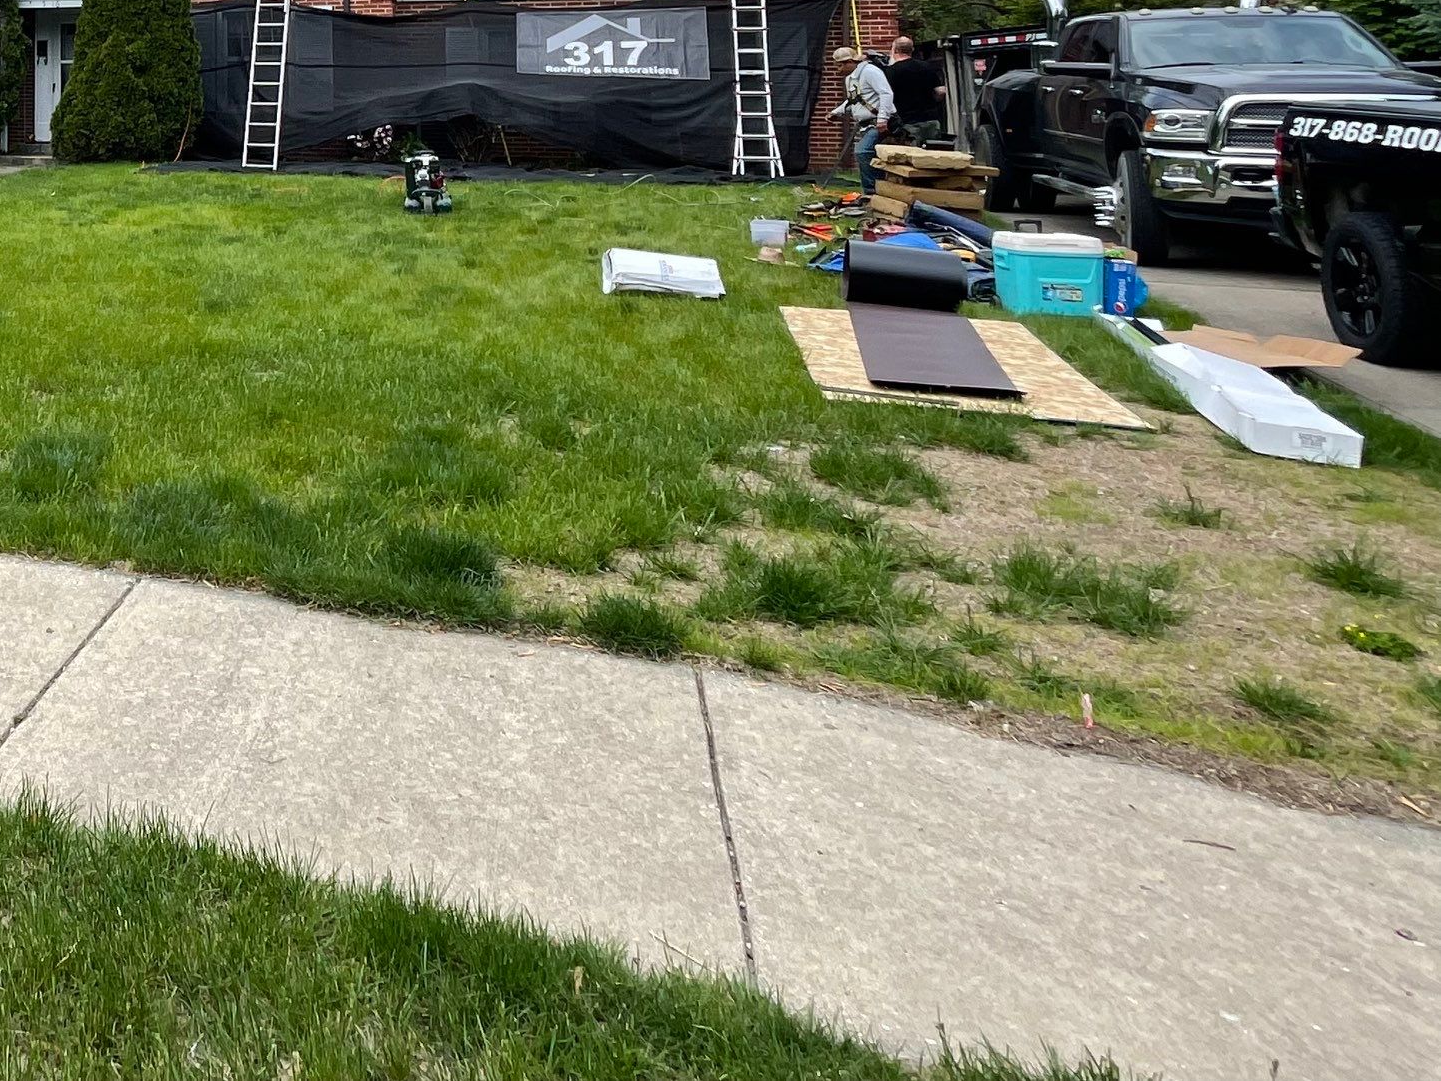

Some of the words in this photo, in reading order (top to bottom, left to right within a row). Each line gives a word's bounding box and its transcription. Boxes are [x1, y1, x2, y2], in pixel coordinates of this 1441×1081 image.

[563, 40, 648, 66] 317
[545, 65, 591, 75] Roofing
[593, 66, 602, 74] &
[603, 65, 680, 75] Restorations
[1288, 116, 1441, 153] 317-868-ROO
